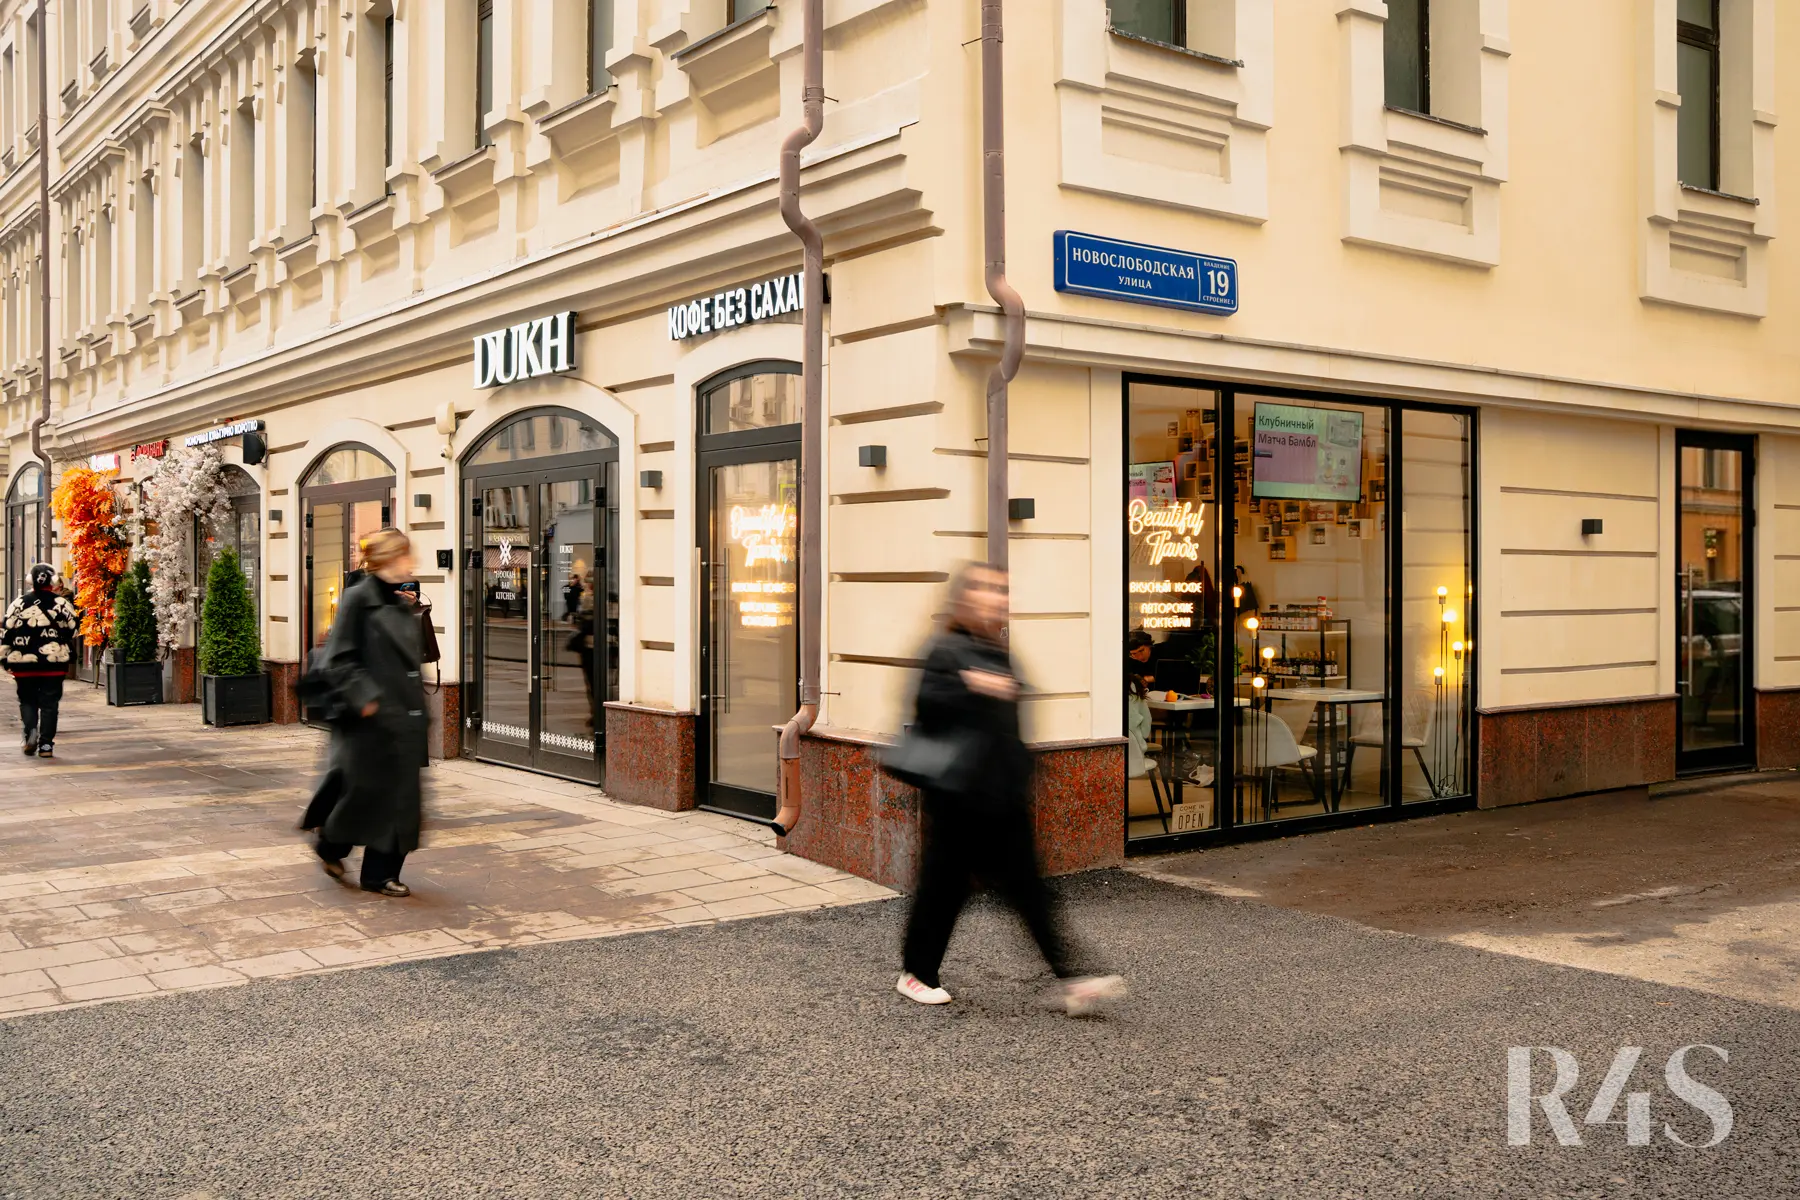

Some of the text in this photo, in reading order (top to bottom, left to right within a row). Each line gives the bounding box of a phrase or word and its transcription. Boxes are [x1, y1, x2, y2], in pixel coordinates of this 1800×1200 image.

[1073, 247, 1195, 280] НОВОСЛОБОДСКАЯ
[1118, 276, 1152, 289] УЛИЦА
[1207, 269, 1229, 297] 19
[1202, 295, 1230, 305] СТРОЕНИЕ
[668, 297, 711, 341] КОФЕ
[714, 287, 746, 329] БЕЗ
[473, 311, 573, 390] DUKH
[1259, 416, 1314, 430] Клубничный
[1258, 434, 1316, 448] Матча Бамбл
[1129, 499, 1205, 536] Beautiful
[1129, 580, 1202, 593] ВКУСНЫЙ КОФЕ
[495, 591, 516, 600] KITCHEN
[1140, 603, 1194, 614] АВТОРСКИЕ
[1143, 615, 1191, 628] КОКТЕЙЛИ
[1178, 813, 1204, 830] OPEN
